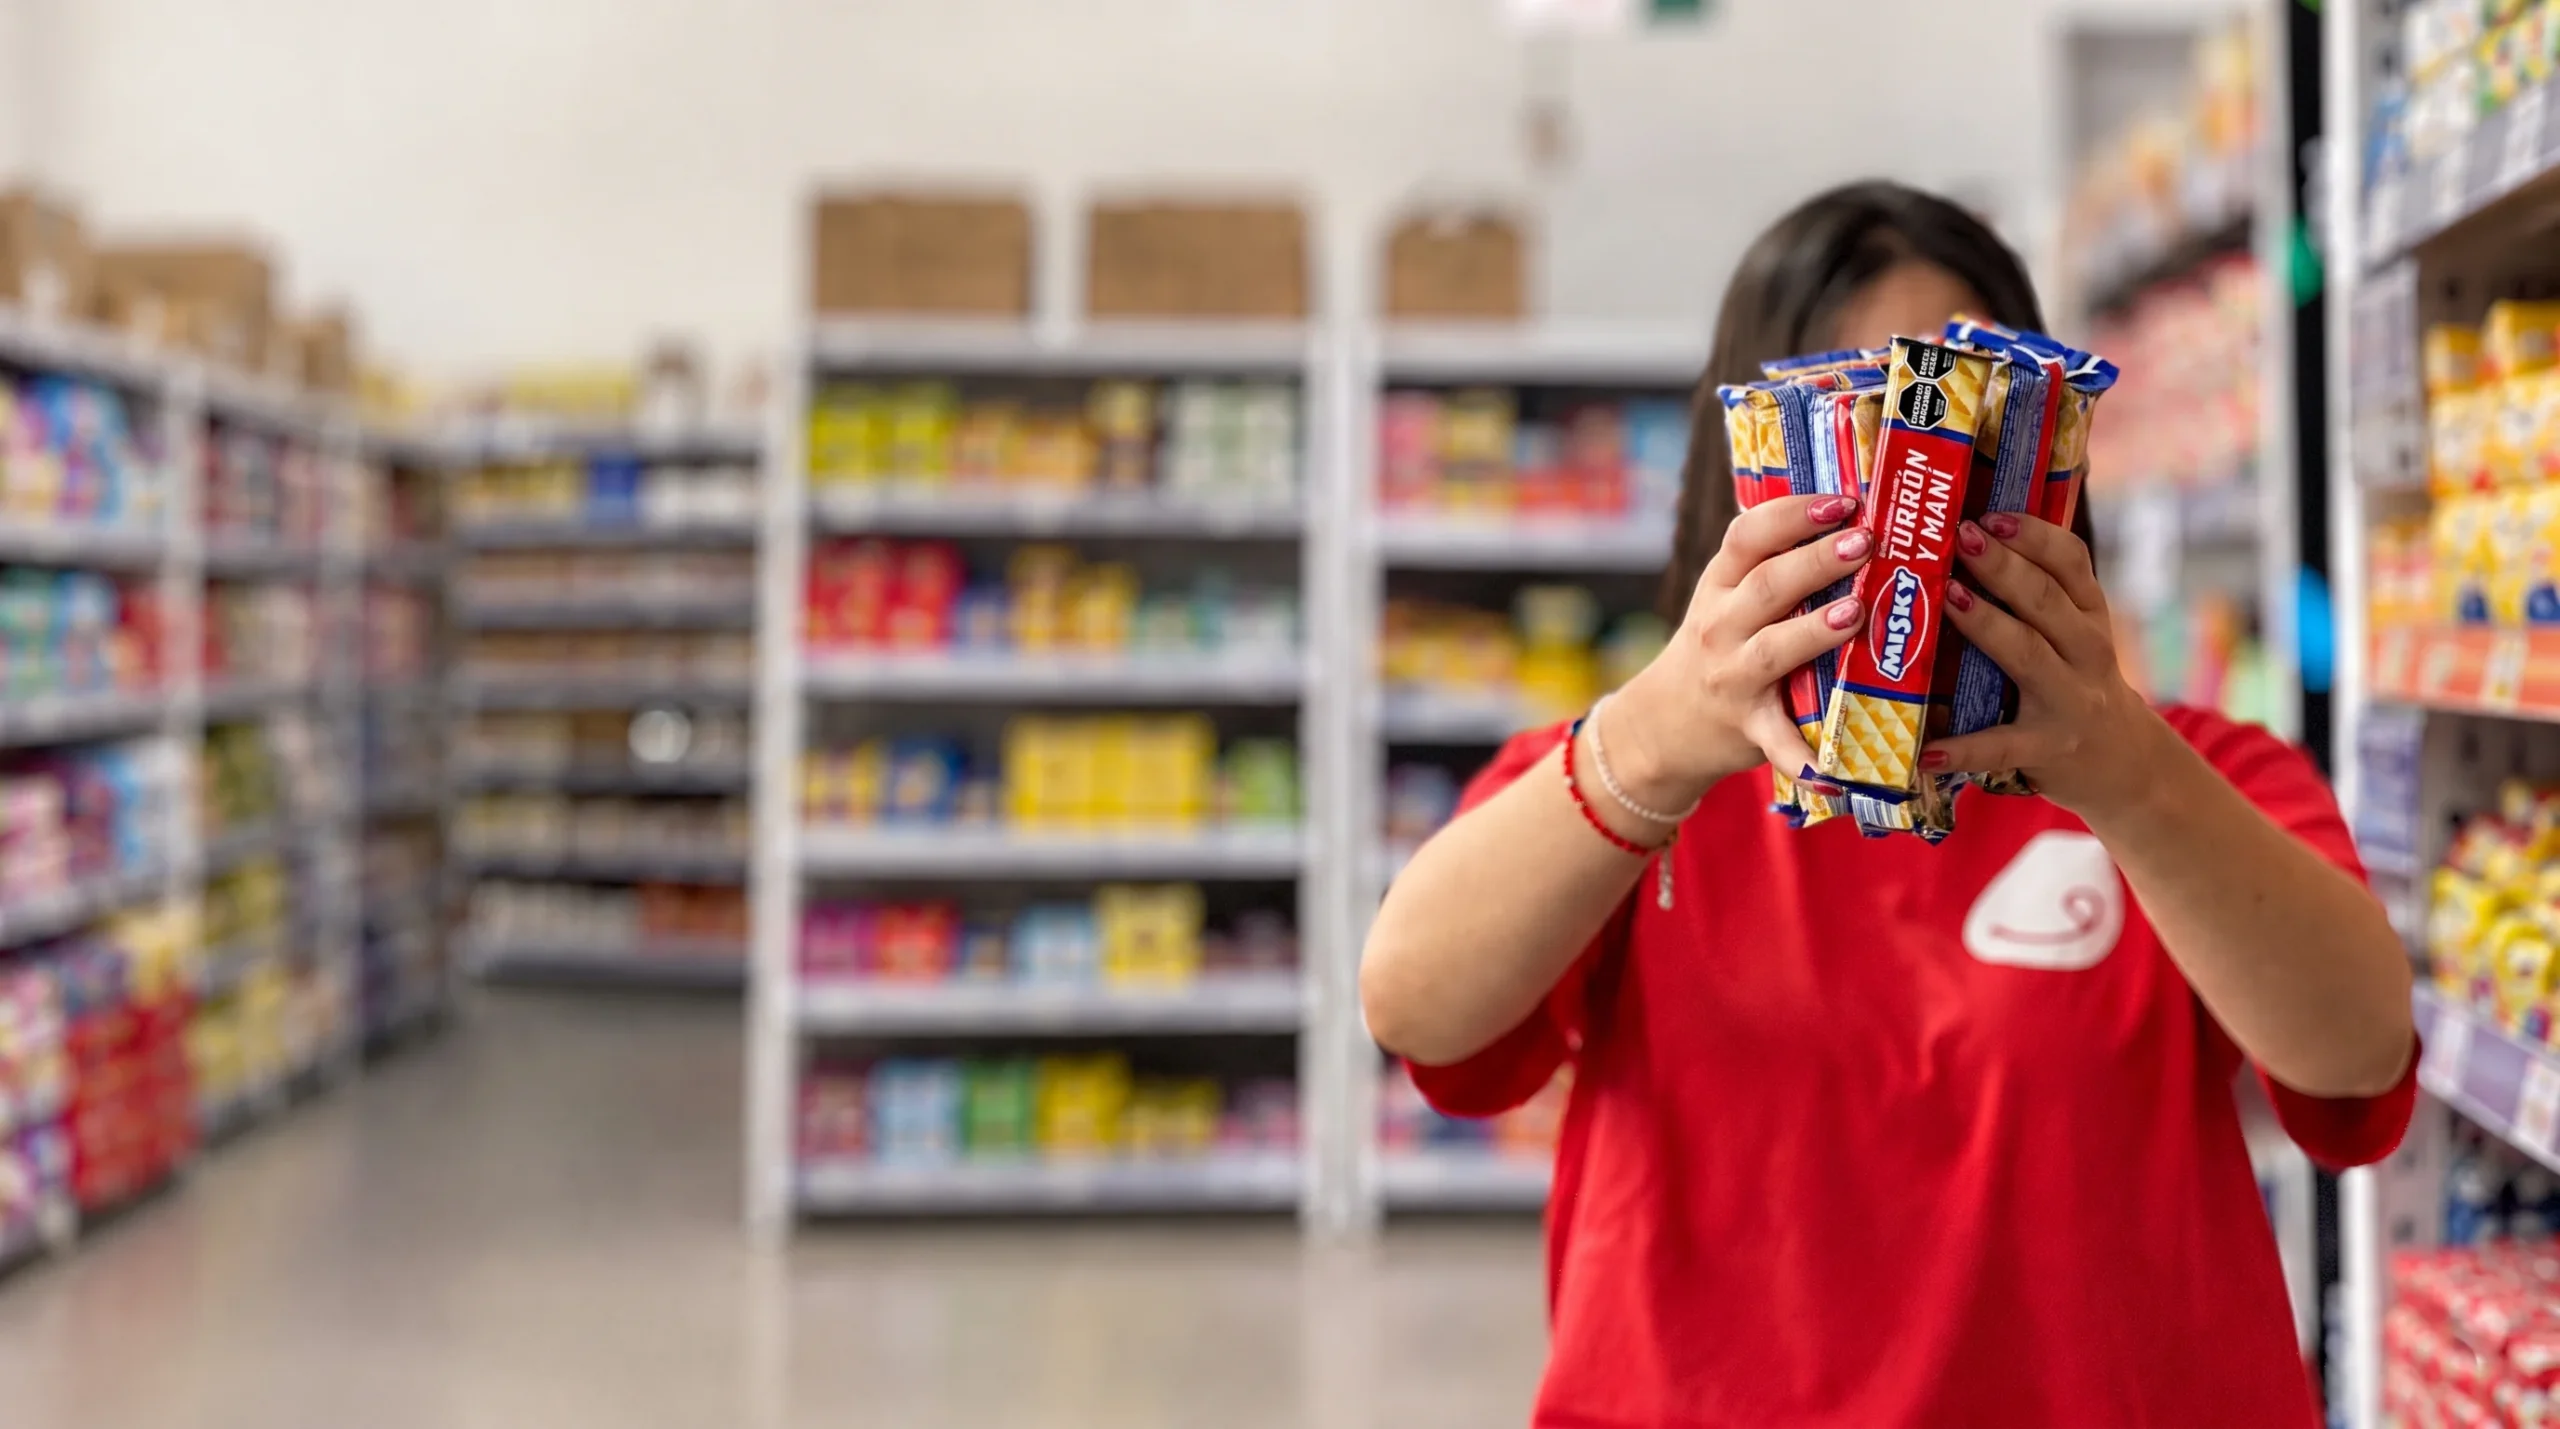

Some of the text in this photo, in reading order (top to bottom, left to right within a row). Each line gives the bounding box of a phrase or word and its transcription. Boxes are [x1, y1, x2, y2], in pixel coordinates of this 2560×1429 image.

[1888, 448, 1928, 561] TURRÓN
[1916, 466, 1954, 561] Y MANÍ
[1881, 570, 1917, 676] MISKY
